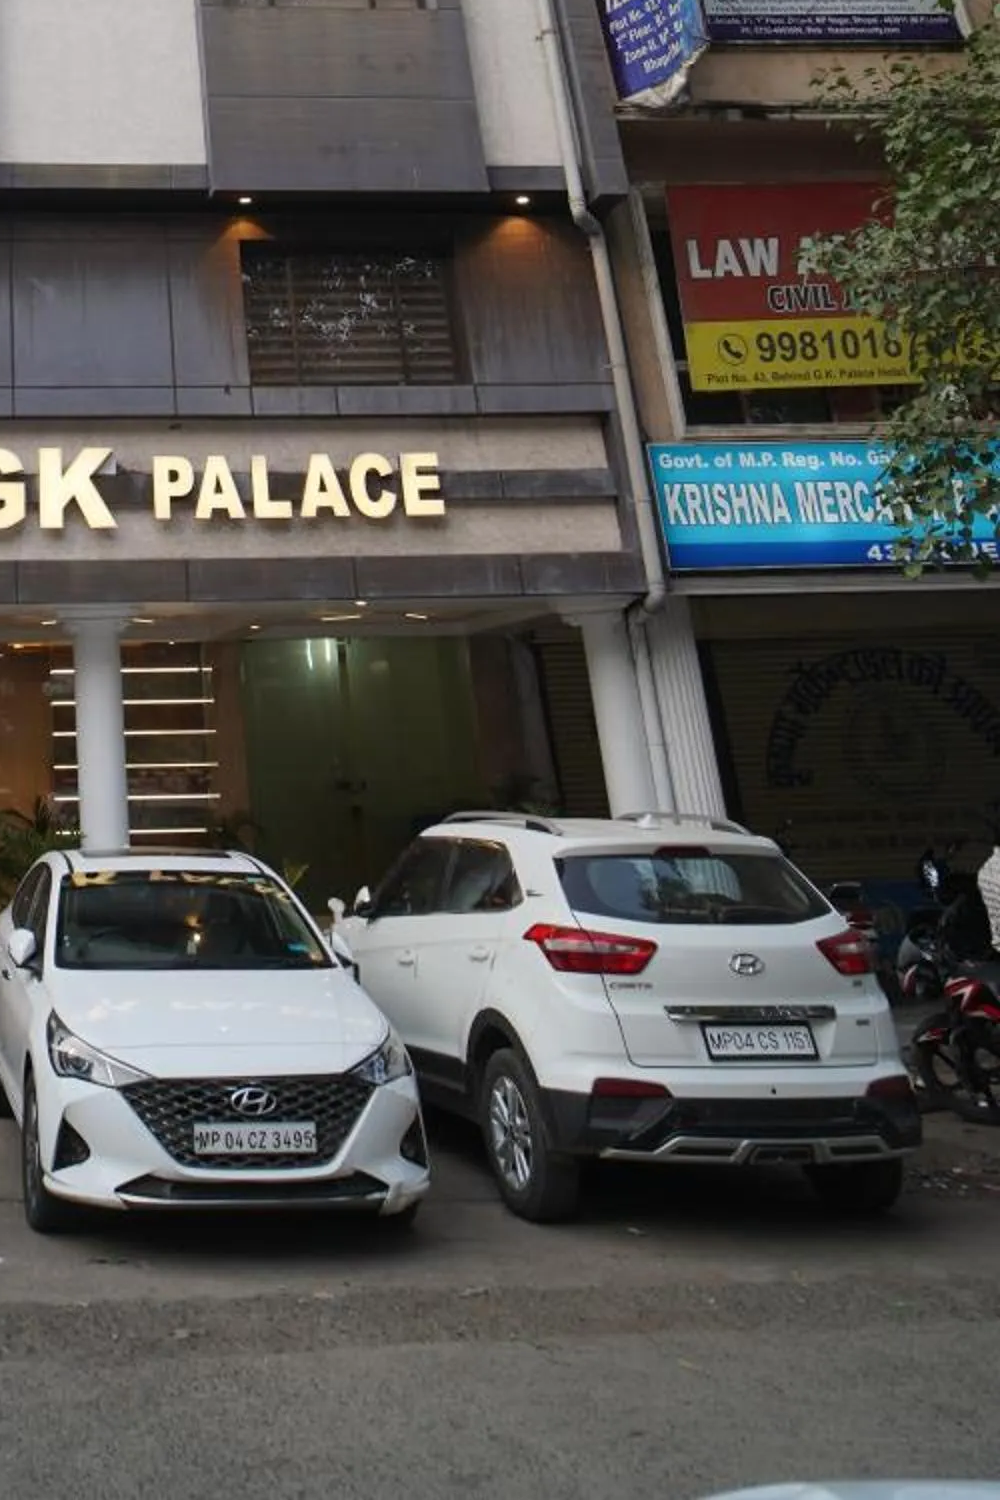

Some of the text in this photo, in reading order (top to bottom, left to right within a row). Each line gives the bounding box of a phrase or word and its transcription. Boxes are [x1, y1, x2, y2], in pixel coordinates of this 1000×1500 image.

[685, 236, 778, 279] LAW
[767, 283, 837, 313] CIVIL
[660, 452, 709, 469] Govt.
[713, 452, 732, 469] of
[739, 451, 777, 468] M.P.
[781, 451, 825, 471] Reg.
[829, 450, 862, 467] No.
[152, 452, 446, 520] PALACE
[663, 481, 793, 526] KRISHNA
[757, 1031, 780, 1052] CS
[199, 1129, 313, 1149] MP 04 CZ 3495
